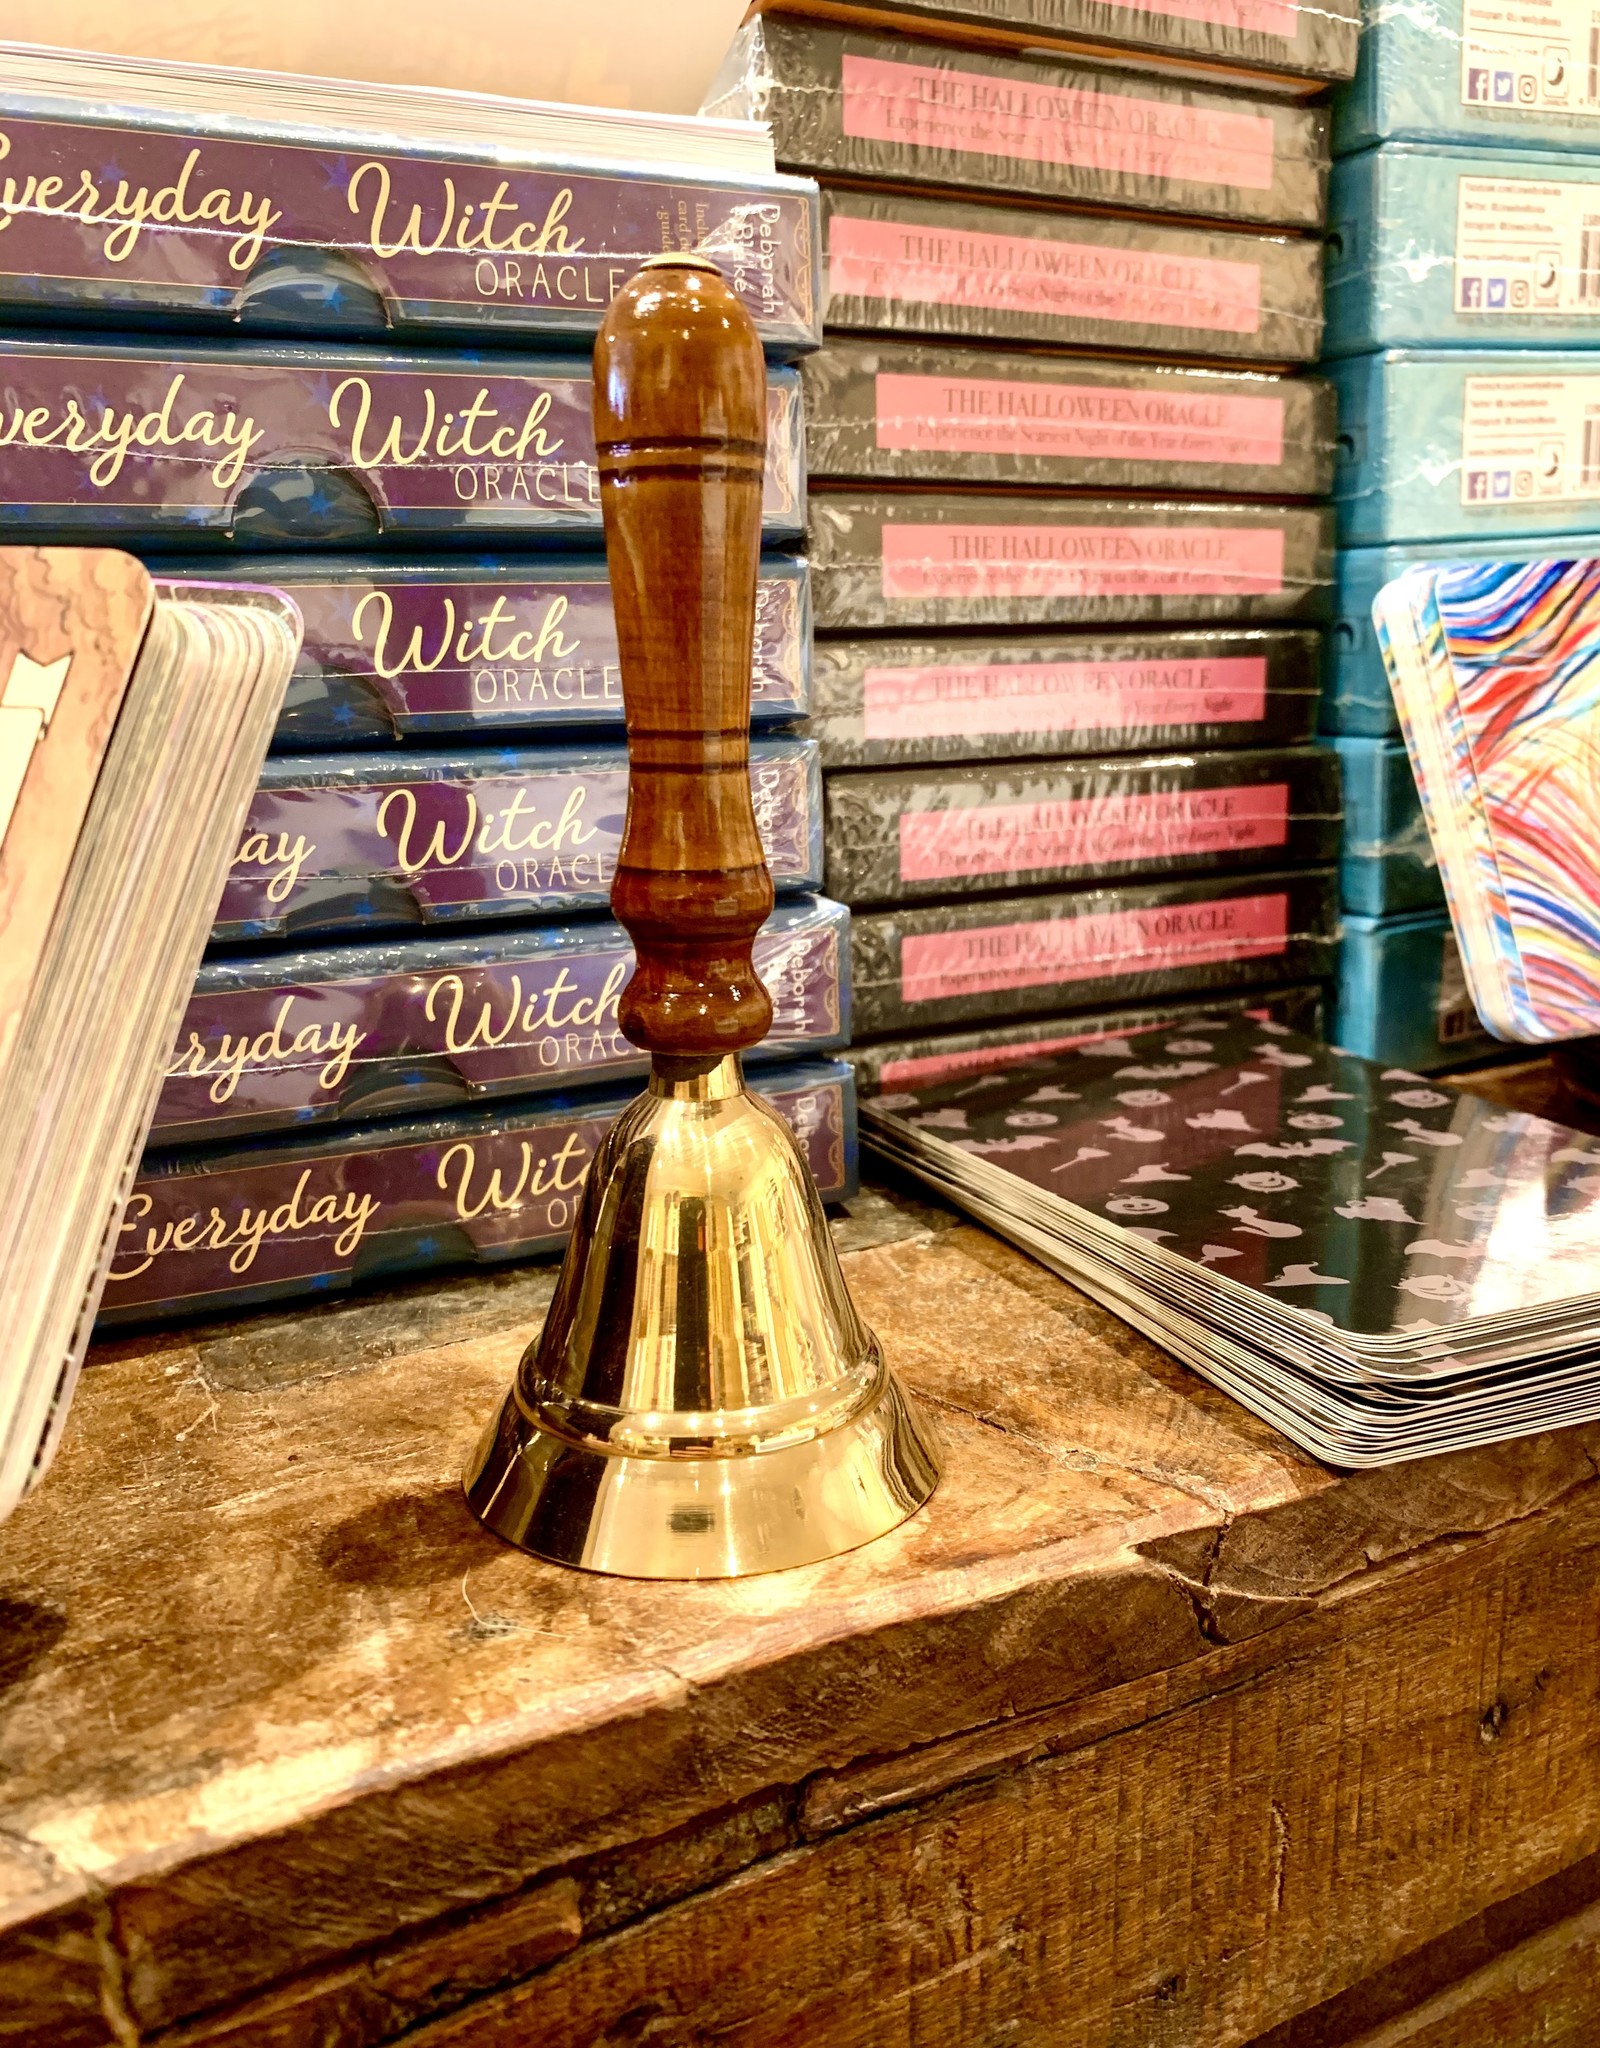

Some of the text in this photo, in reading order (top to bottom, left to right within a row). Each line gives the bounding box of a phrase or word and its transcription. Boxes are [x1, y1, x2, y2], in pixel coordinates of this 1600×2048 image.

[913, 76, 964, 105] THE
[0, 131, 586, 271] veryday Witch
[677, 200, 692, 233] card
[656, 210, 674, 253] guide
[695, 202, 710, 245] Inclu
[759, 203, 784, 314] Deborah
[900, 234, 951, 265] THE
[958, 241, 1107, 279] HALLOWEEN
[475, 258, 625, 303] ORACLE
[943, 388, 1229, 427] THE HALLOWEEN ORACLE
[0, 374, 564, 487] veryday Witch
[917, 423, 993, 443] Experience
[996, 425, 1017, 441] the
[455, 463, 602, 502] ORACLE
[949, 535, 1231, 561] THE HALLOWEEN ORACLE
[351, 591, 580, 679] Witch
[474, 665, 622, 704] ORACLE
[931, 675, 979, 700] THE
[1129, 667, 1213, 690] ORACLE
[376, 784, 598, 874] Witch
[496, 852, 614, 891] ORACL
[963, 932, 1010, 959] THE
[1154, 908, 1236, 936] ORACLE
[790, 939, 815, 1034] Deborah
[168, 962, 626, 1104] ryday Witch
[539, 1029, 651, 1067] ORAC
[796, 1096, 819, 1177] Debo
[106, 1132, 592, 1281] Everyday Wit
